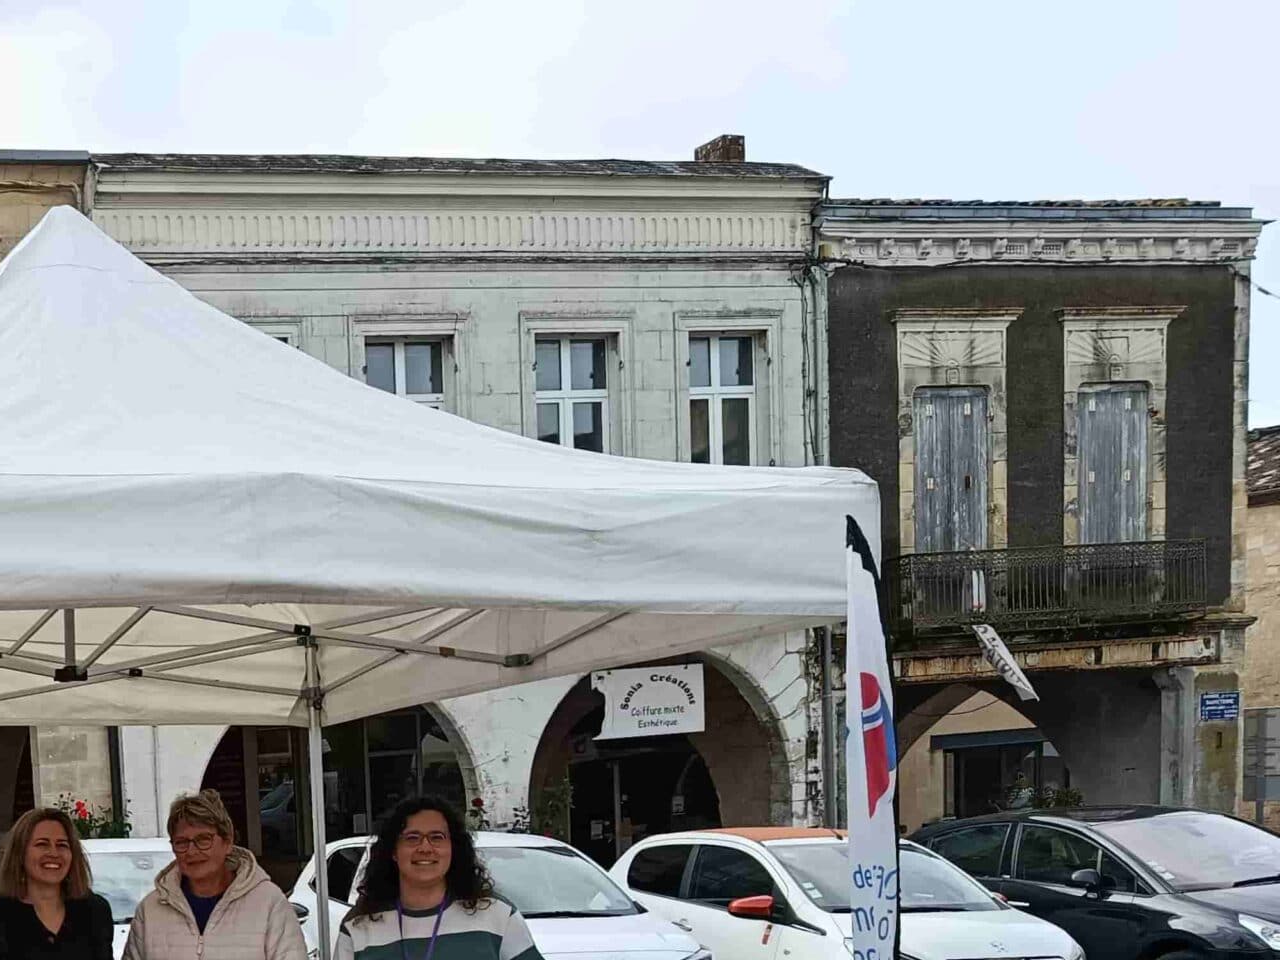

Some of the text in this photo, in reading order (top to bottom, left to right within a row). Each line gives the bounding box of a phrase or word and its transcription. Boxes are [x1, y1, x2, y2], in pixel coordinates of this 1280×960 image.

[620, 674, 696, 710] Sonia Créations
[631, 704, 685, 717] Coiffure mixte
[638, 718, 678, 729] Esthétique
